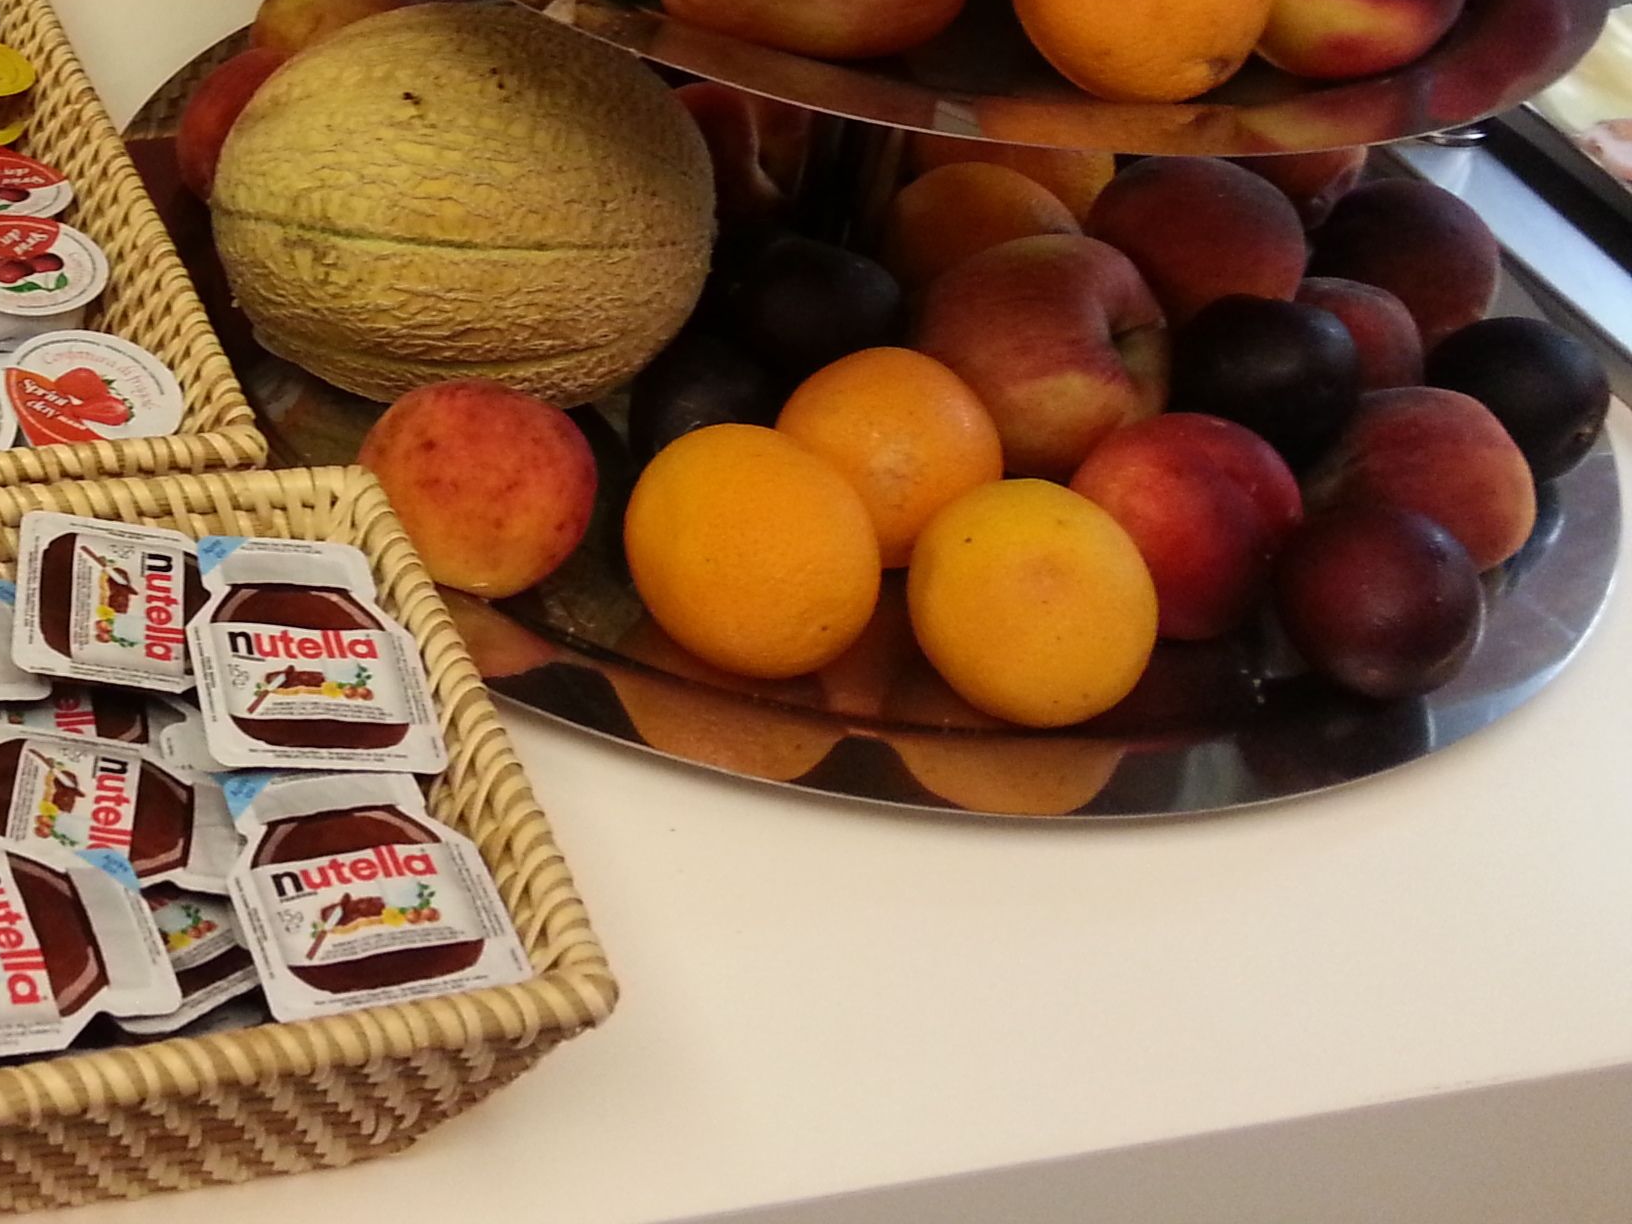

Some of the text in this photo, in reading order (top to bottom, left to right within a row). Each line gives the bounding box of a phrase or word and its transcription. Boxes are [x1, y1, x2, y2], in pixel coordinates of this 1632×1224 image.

[22, 377, 70, 407] Sprint
[145, 552, 186, 663] nutella
[227, 628, 379, 661] nutella
[85, 755, 133, 850] nutell
[270, 844, 438, 898] nutella
